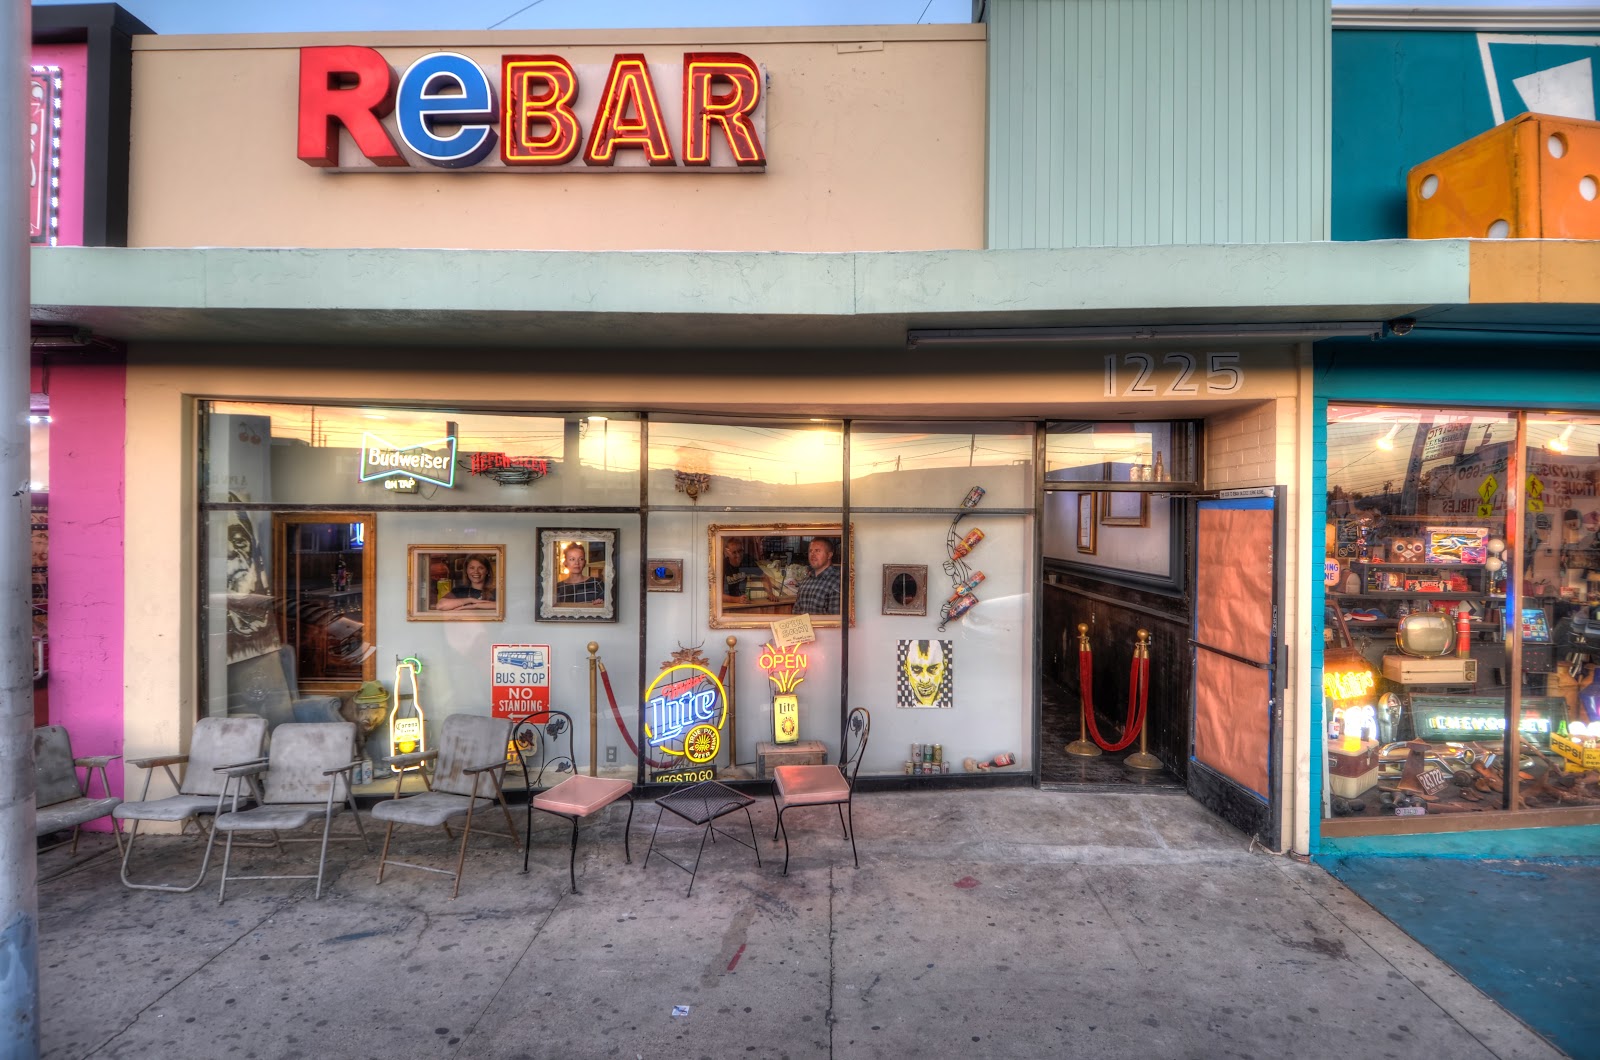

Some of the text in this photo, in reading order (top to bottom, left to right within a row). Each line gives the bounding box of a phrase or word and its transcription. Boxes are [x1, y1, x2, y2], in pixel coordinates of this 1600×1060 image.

[297, 45, 767, 170] ReBAR
[1103, 352, 1245, 397] 1225
[368, 447, 450, 470] Budweiser
[398, 477, 416, 490] TAP
[759, 654, 807, 669] OPEN
[496, 672, 546, 684] BUS STOP
[508, 688, 533, 699] NO
[498, 699, 543, 712] STANDING
[779, 702, 796, 715] Lite
[689, 729, 701, 744] TRUE
[703, 728, 717, 751] PILSNER
[1551, 738, 1582, 760] PEPSI
[656, 769, 713, 783] KEGS TO GO
